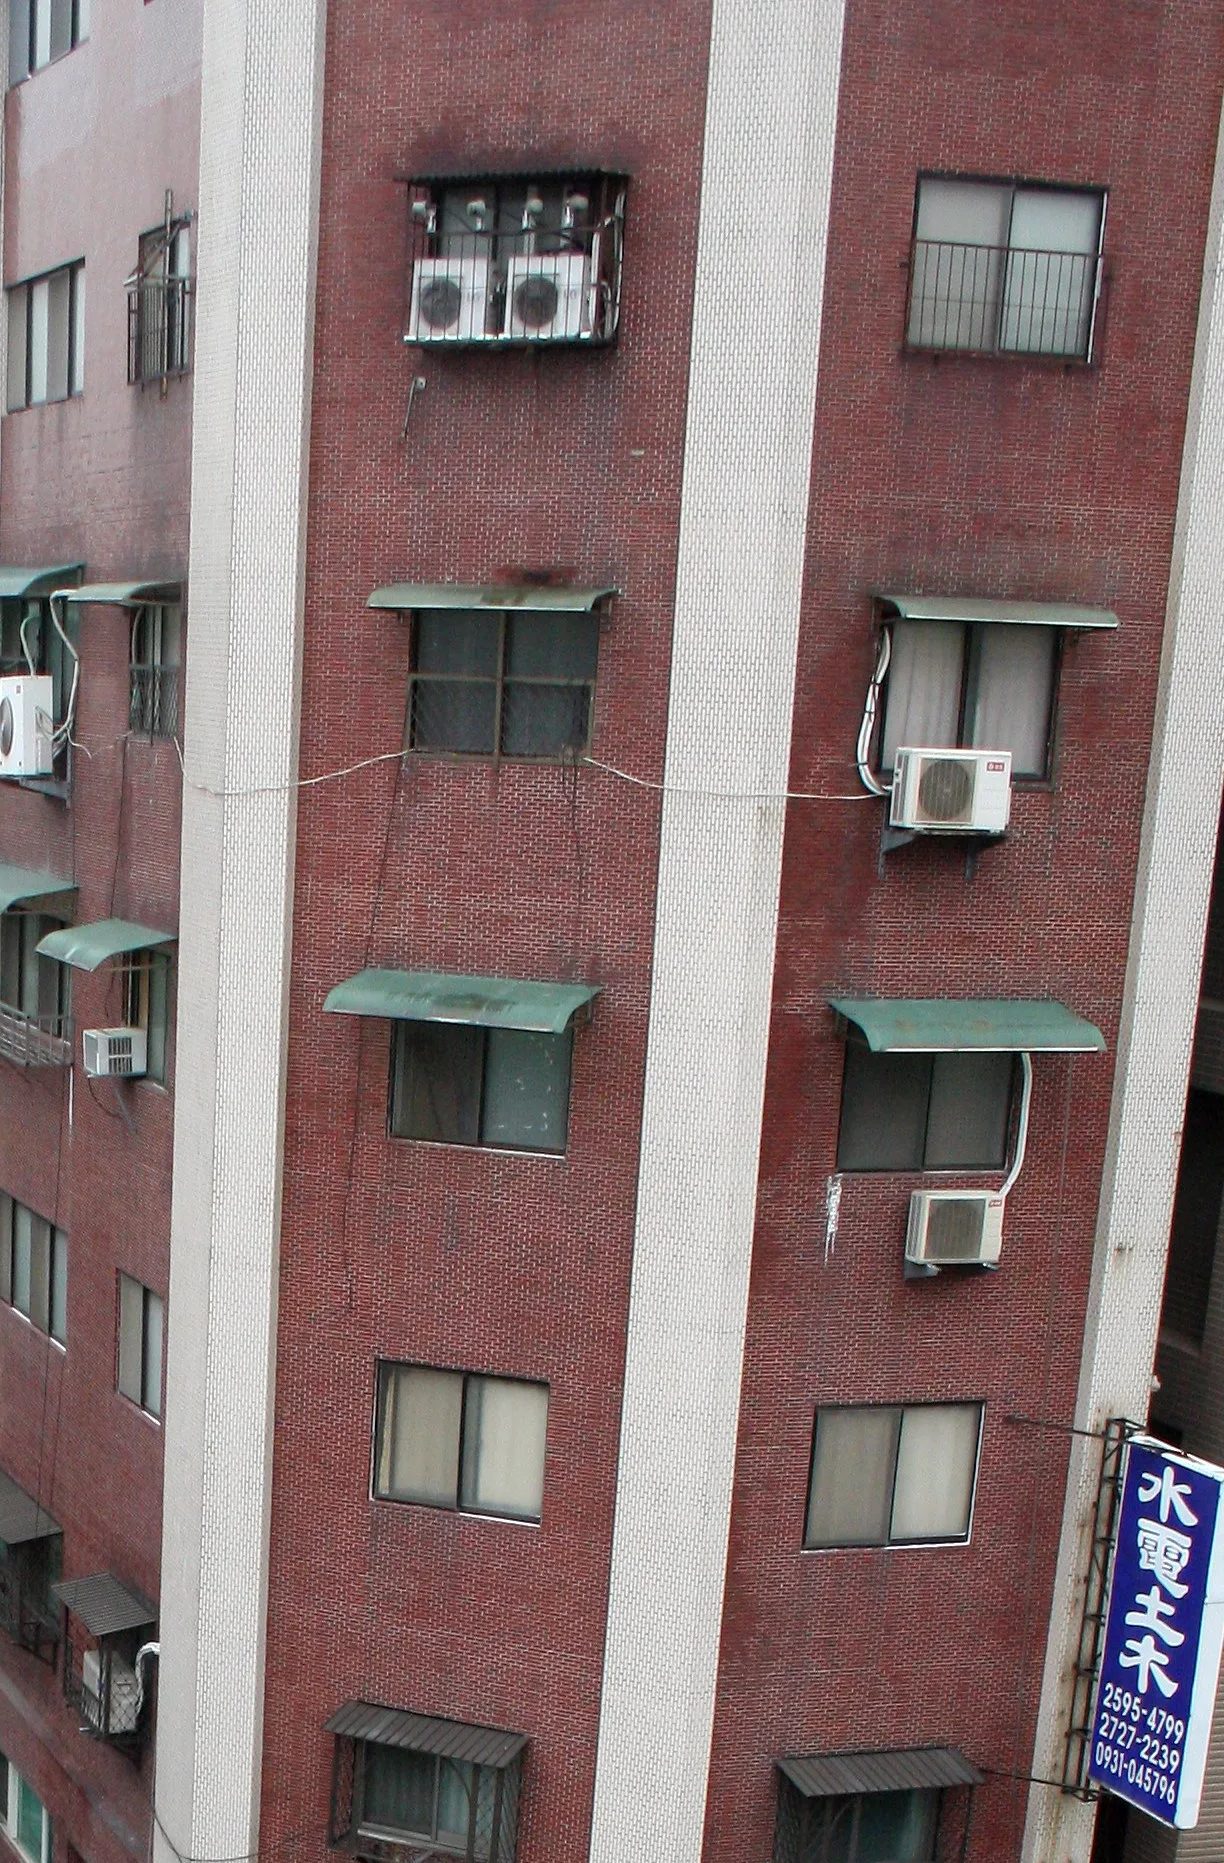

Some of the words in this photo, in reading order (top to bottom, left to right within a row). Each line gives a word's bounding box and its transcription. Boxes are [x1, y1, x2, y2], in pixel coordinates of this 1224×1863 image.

[1119, 1465, 1198, 1699] 水電土木
[1100, 1713, 1181, 1774] 2727-2239
[1102, 1682, 1184, 1744] 2595-4799
[1095, 1742, 1176, 1806] 0931-045796
